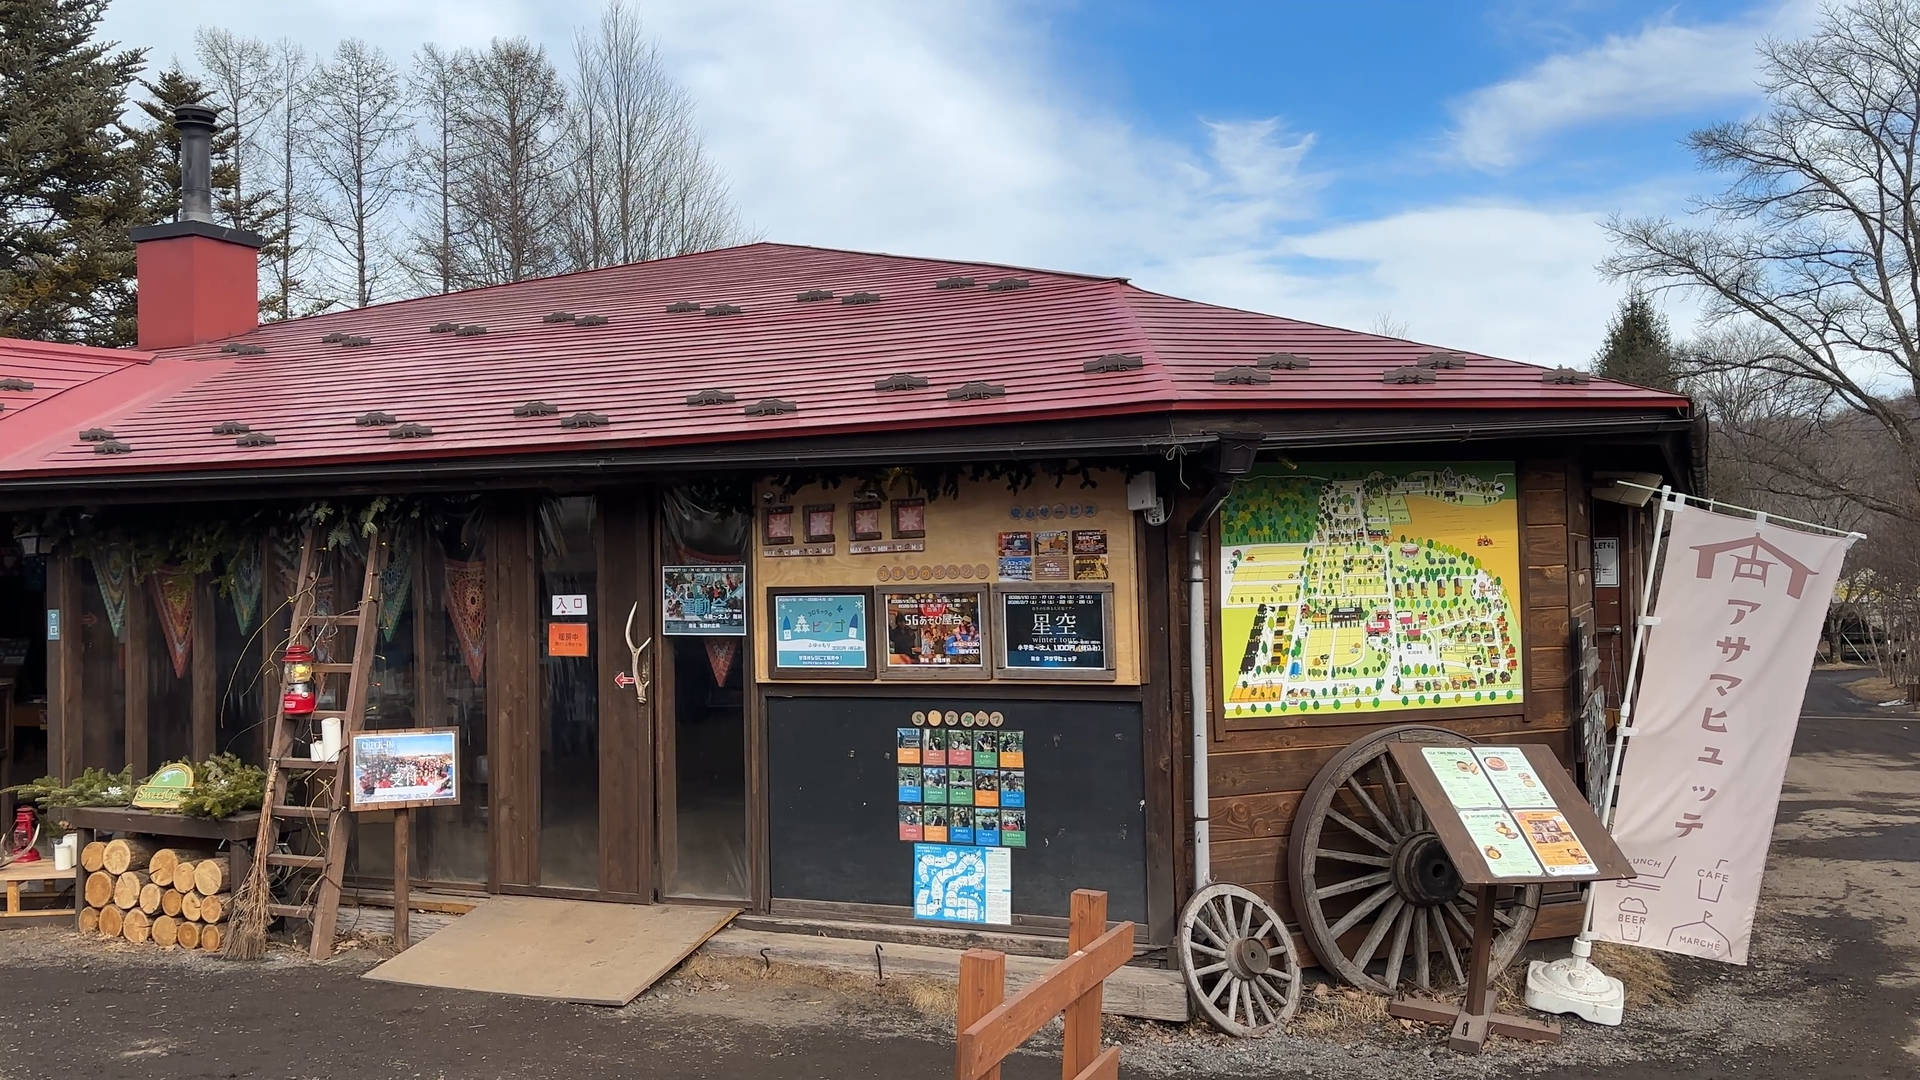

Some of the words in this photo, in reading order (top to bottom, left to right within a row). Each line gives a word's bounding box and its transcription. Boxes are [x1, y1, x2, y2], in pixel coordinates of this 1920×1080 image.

[556, 597, 582, 610] 入口
[1031, 613, 1077, 635] 星空
[1674, 599, 1761, 838] アサマヒュッテ
[1628, 858, 1661, 868] UNCH
[1697, 868, 1729, 883] CAFE
[1618, 913, 1646, 925] BEER
[1679, 935, 1721, 952] MARCHÉ
